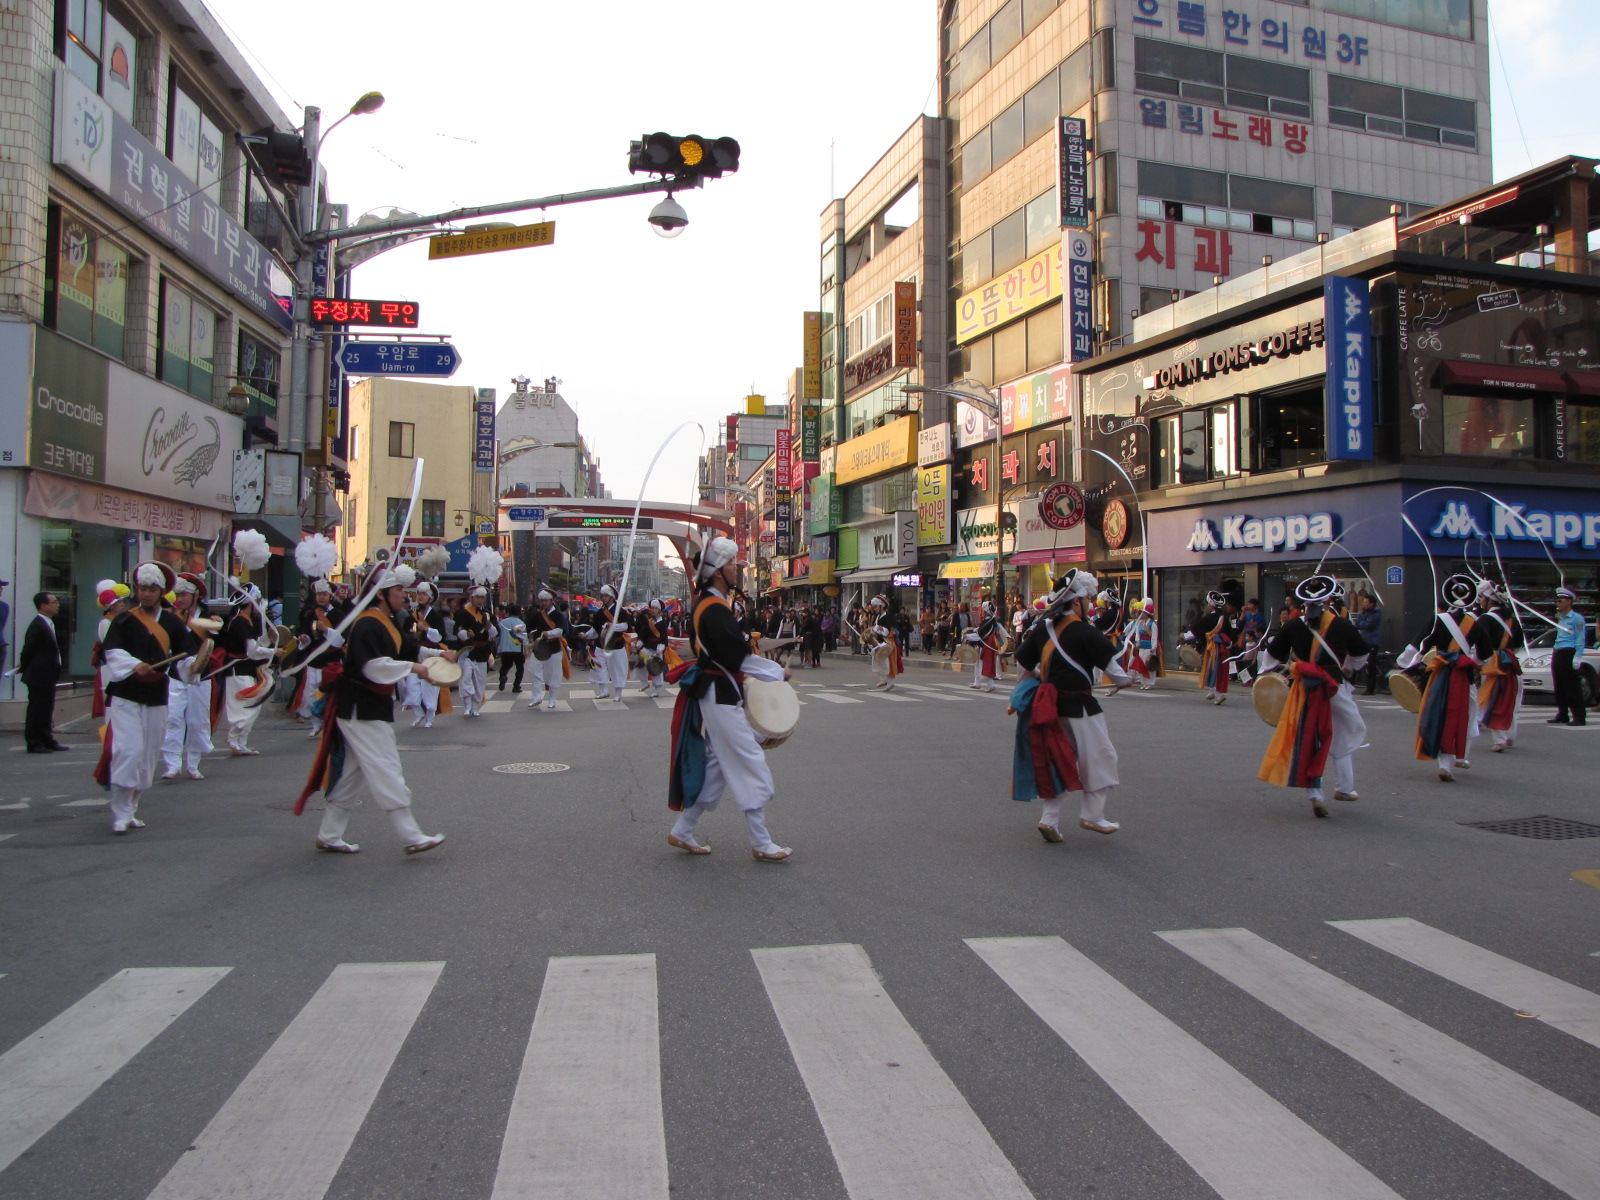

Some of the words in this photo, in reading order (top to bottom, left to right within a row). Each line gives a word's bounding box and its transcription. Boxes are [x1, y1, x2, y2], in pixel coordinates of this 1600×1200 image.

[1336, 33, 1368, 66] 3F
[476, 233, 499, 249] 단속용
[1135, 221, 1233, 277] 치과
[313, 300, 370, 322] 주정차
[1072, 264, 1090, 354] 연합치과
[1399, 288, 1407, 317] LATTE
[1400, 319, 1408, 350] CAFFE
[346, 353, 360, 364] 25
[376, 346, 420, 361] 우암로
[381, 362, 416, 373] Uam-ro
[436, 355, 451, 366] 29
[1150, 363, 1183, 390] TOM
[1186, 357, 1200, 379] N
[1203, 341, 1251, 374] TOMS
[1257, 317, 1325, 358] COFFE
[37, 386, 104, 427] Crocodile
[1035, 377, 1069, 413] 치과
[1343, 332, 1364, 452] Kappa
[1555, 399, 1563, 429] LATTE
[142, 406, 198, 476] Crocodile
[1556, 429, 1564, 459] CAFFE
[44, 442, 95, 476] 크로커다일
[922, 469, 942, 496] 으뜸
[1046, 487, 1060, 504] TOM
[1068, 487, 1082, 510] TOMS
[93, 493, 121, 521] 새로운
[143, 502, 160, 528] 가을
[919, 498, 945, 532] 한의원
[1047, 510, 1080, 527] COFFEE
[777, 504, 790, 550] 한의원
[1222, 512, 1333, 553] Kappa
